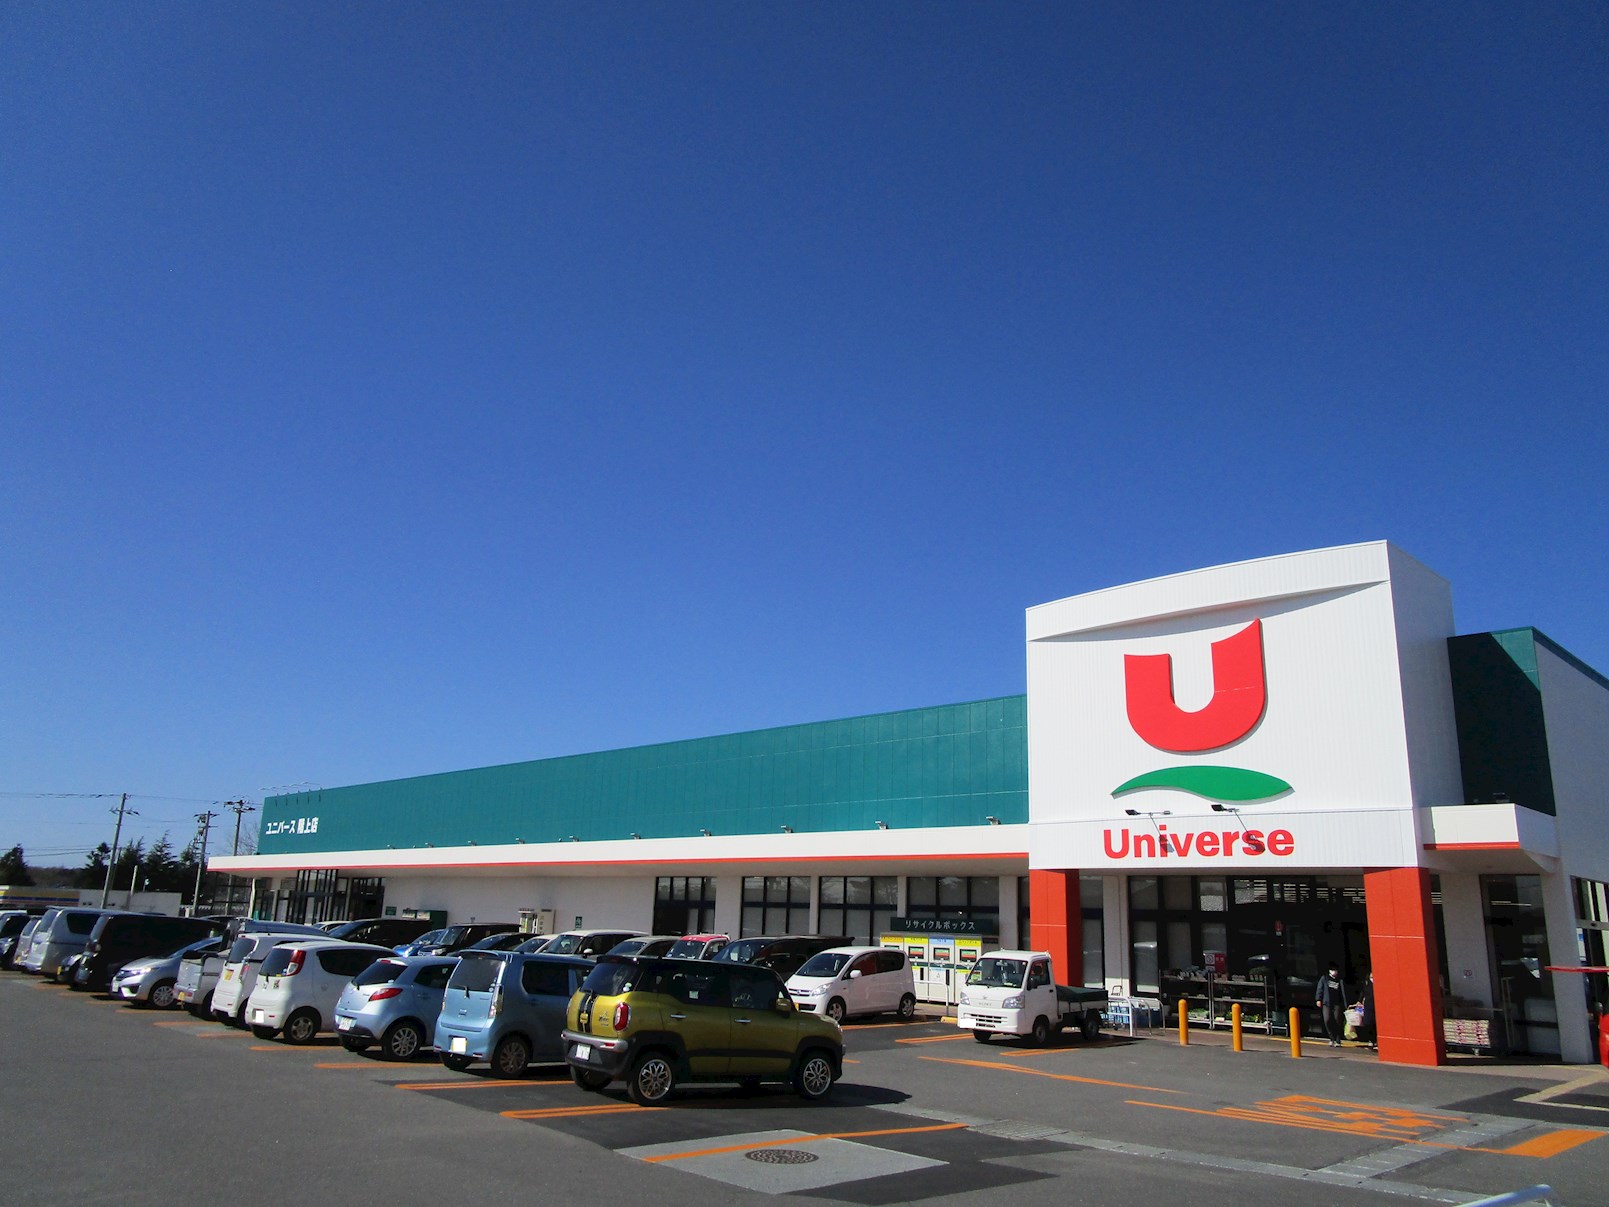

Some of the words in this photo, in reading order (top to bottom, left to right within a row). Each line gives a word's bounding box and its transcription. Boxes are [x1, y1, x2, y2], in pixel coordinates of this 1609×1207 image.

[1124, 618, 1266, 752] U
[265, 820, 296, 835] ユニバース
[1103, 824, 1295, 860] Universe
[905, 920, 975, 930] リサイクルボックス
